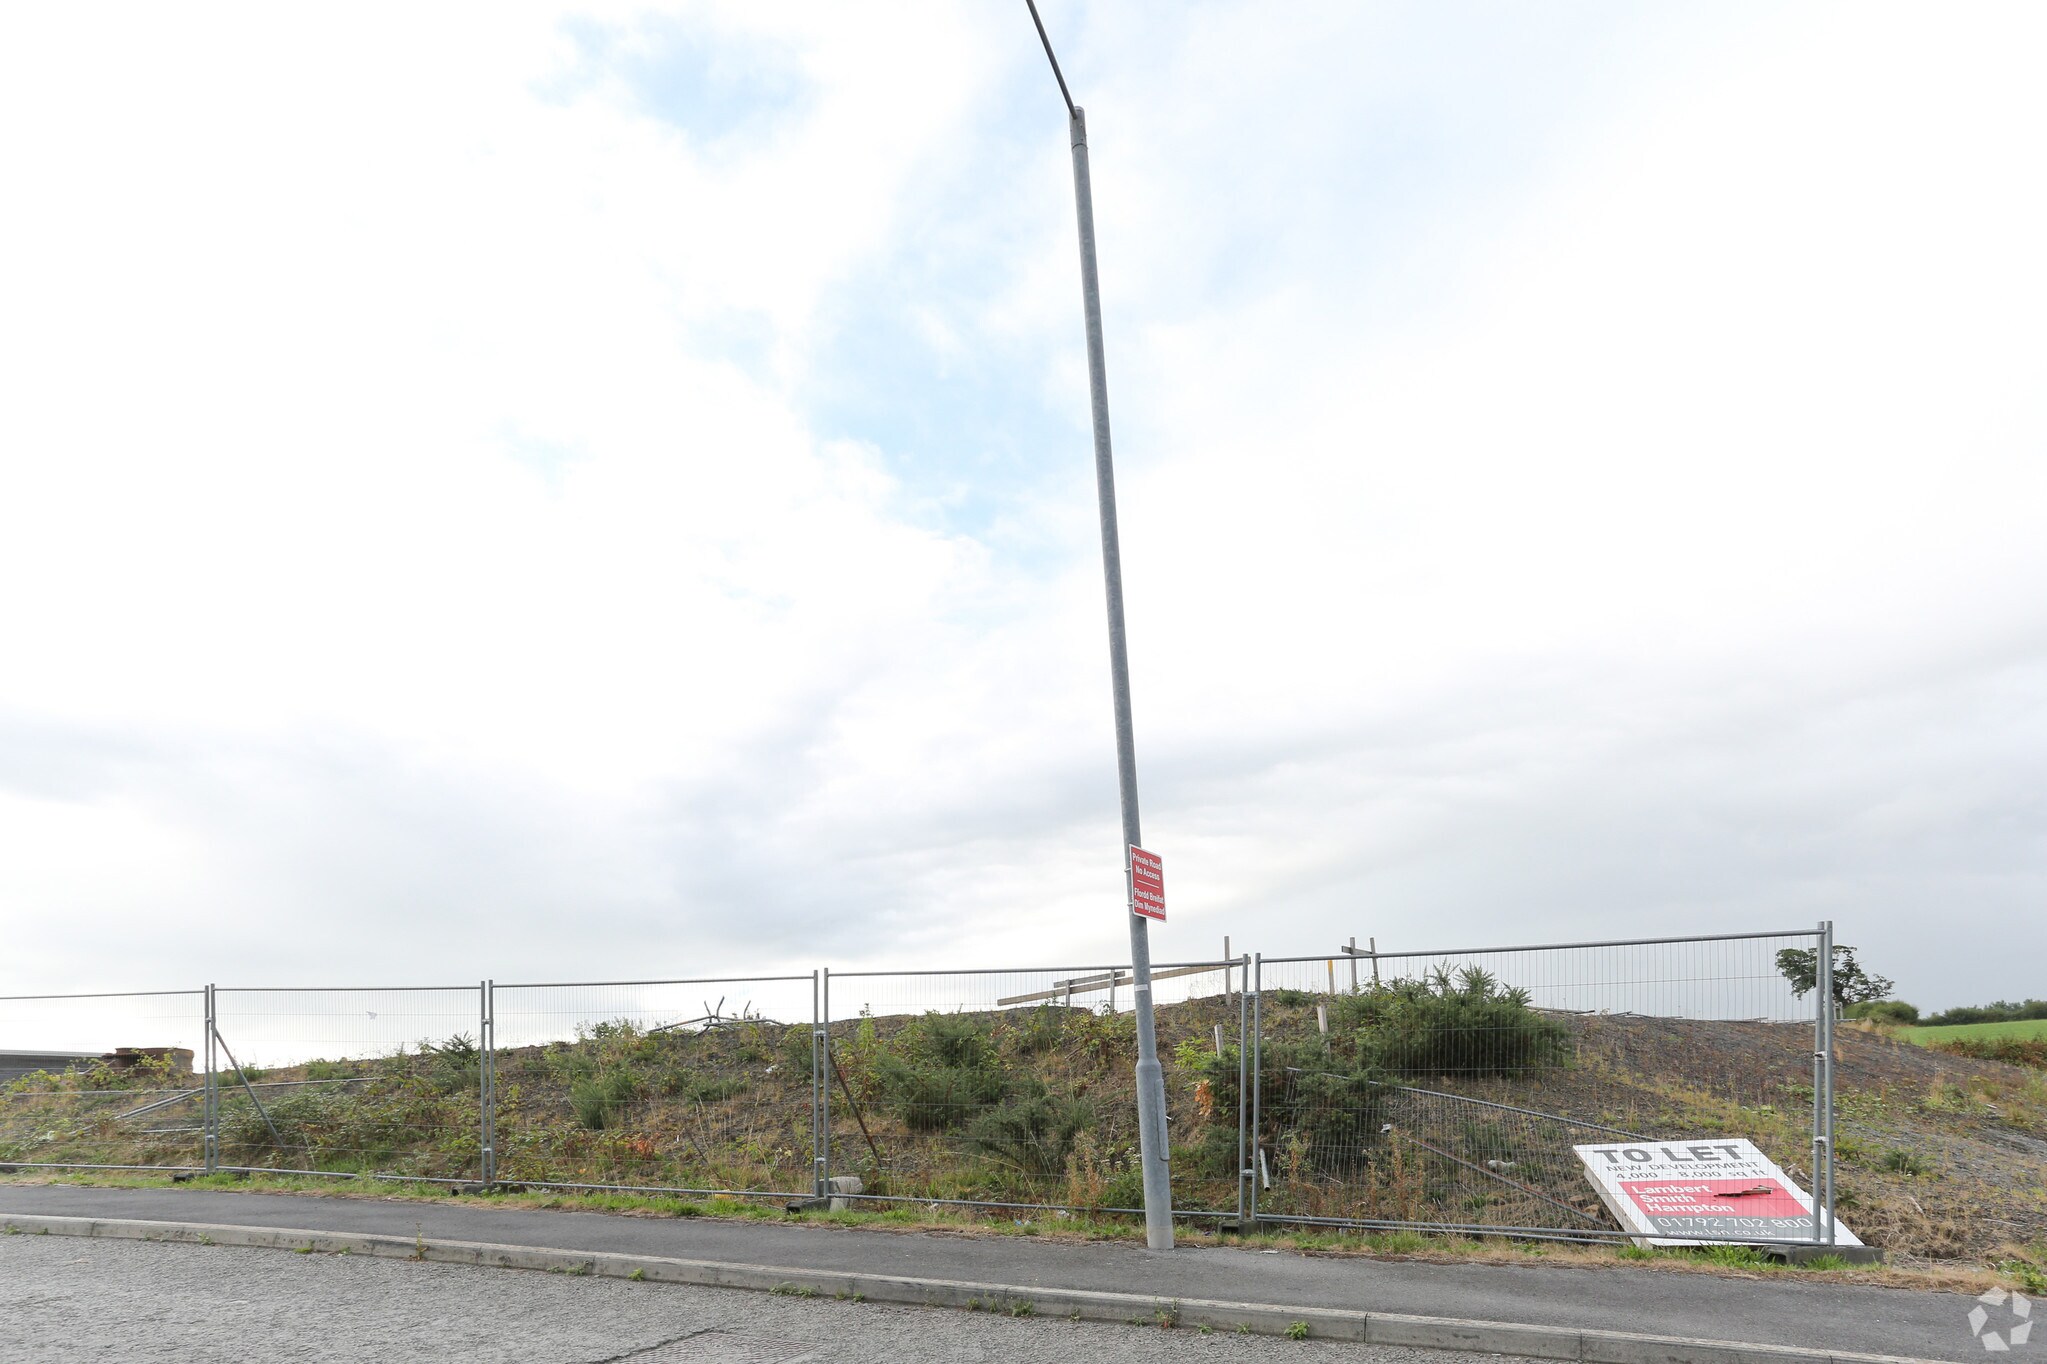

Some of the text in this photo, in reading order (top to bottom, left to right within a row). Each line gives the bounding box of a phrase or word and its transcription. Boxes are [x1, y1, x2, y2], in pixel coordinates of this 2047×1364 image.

[1132, 852, 1162, 871] Private Road
[1135, 864, 1160, 881] No Access
[1135, 898, 1165, 915] Dim Mynediad
[1593, 1144, 1743, 1163] TO LET
[1648, 1161, 1760, 1171] DEVELOPMENT
[1616, 1172, 1659, 1180] 4,000
[1678, 1171, 1722, 1179] 8,000
[1631, 1184, 1713, 1195] Lambert
[1640, 1193, 1697, 1203] Smith
[1645, 1203, 1736, 1214] Hampton
[1657, 1217, 1814, 1229] 01792 702 800
